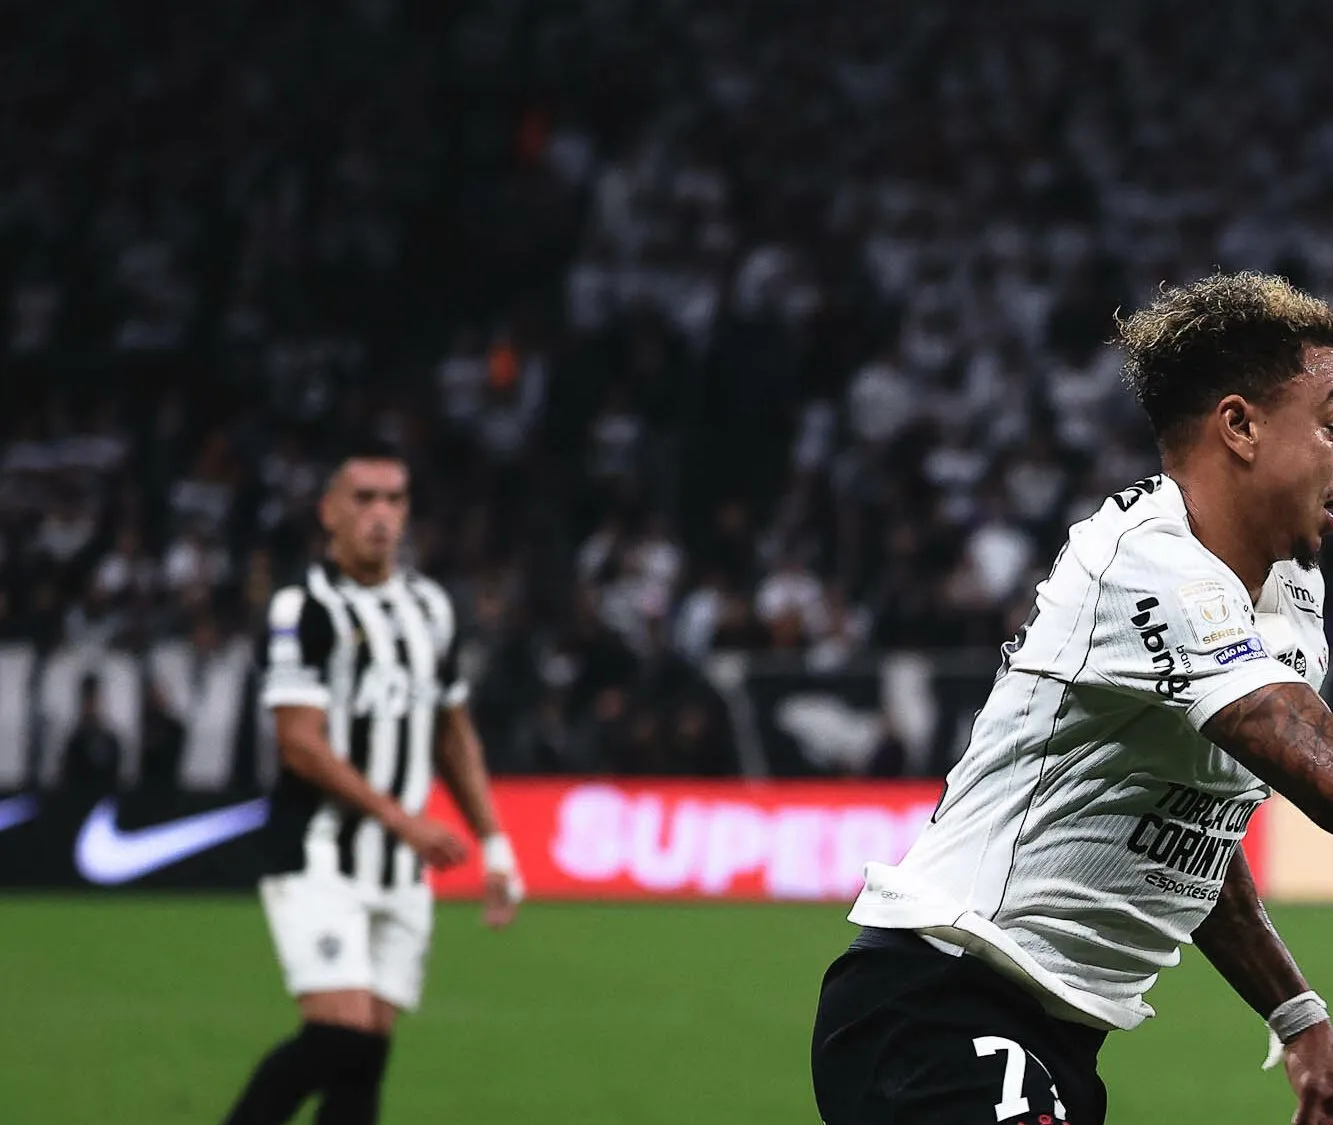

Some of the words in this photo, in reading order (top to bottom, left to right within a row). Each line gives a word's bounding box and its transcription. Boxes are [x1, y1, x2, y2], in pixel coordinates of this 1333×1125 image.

[1140, 622, 1192, 698] bmg
[550, 782, 935, 900] SUPER
[1154, 781, 1232, 837] TORÇA
[972, 1035, 1067, 1122] 7
